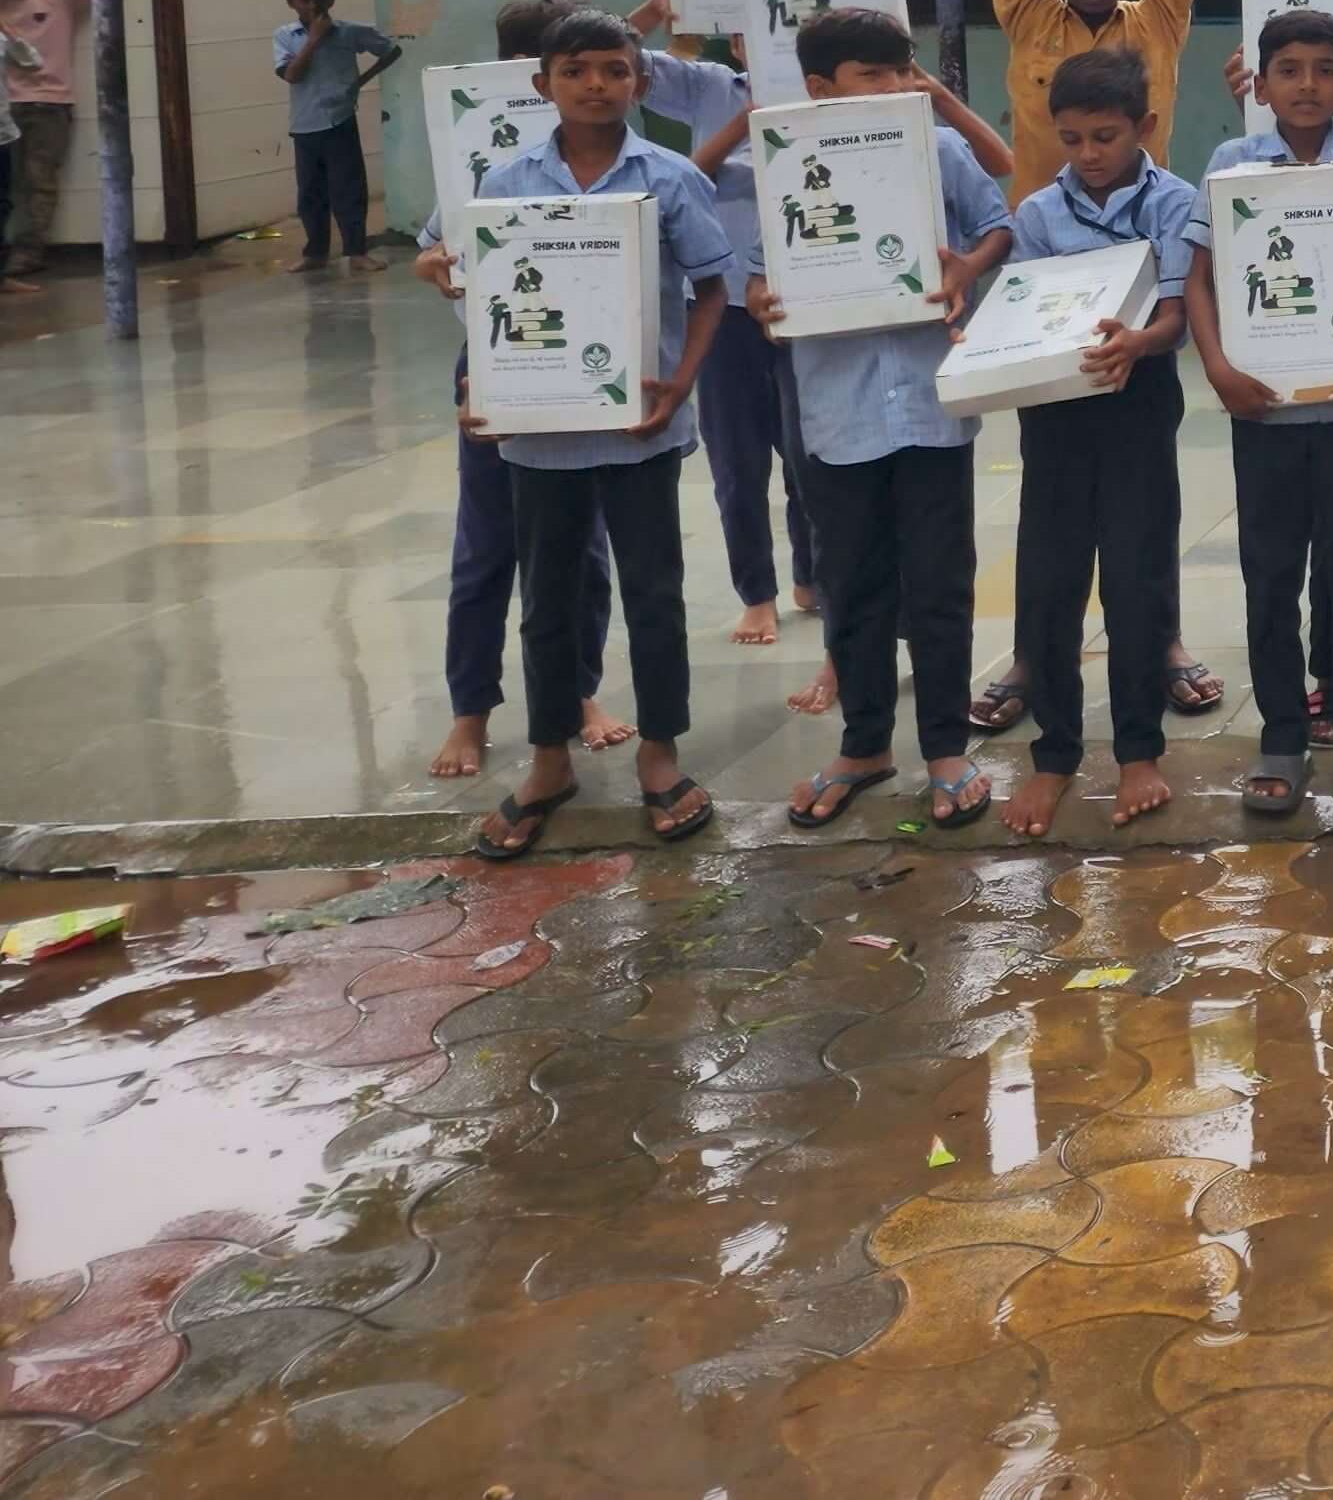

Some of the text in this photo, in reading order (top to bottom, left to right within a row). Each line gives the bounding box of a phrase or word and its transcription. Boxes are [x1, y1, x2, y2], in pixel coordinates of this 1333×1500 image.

[819, 131, 903, 148] SHIKSHA VRIDDHI
[1284, 209, 1323, 220] SHIKSHA
[533, 241, 620, 251] SHIKSHA VRIDDHI
